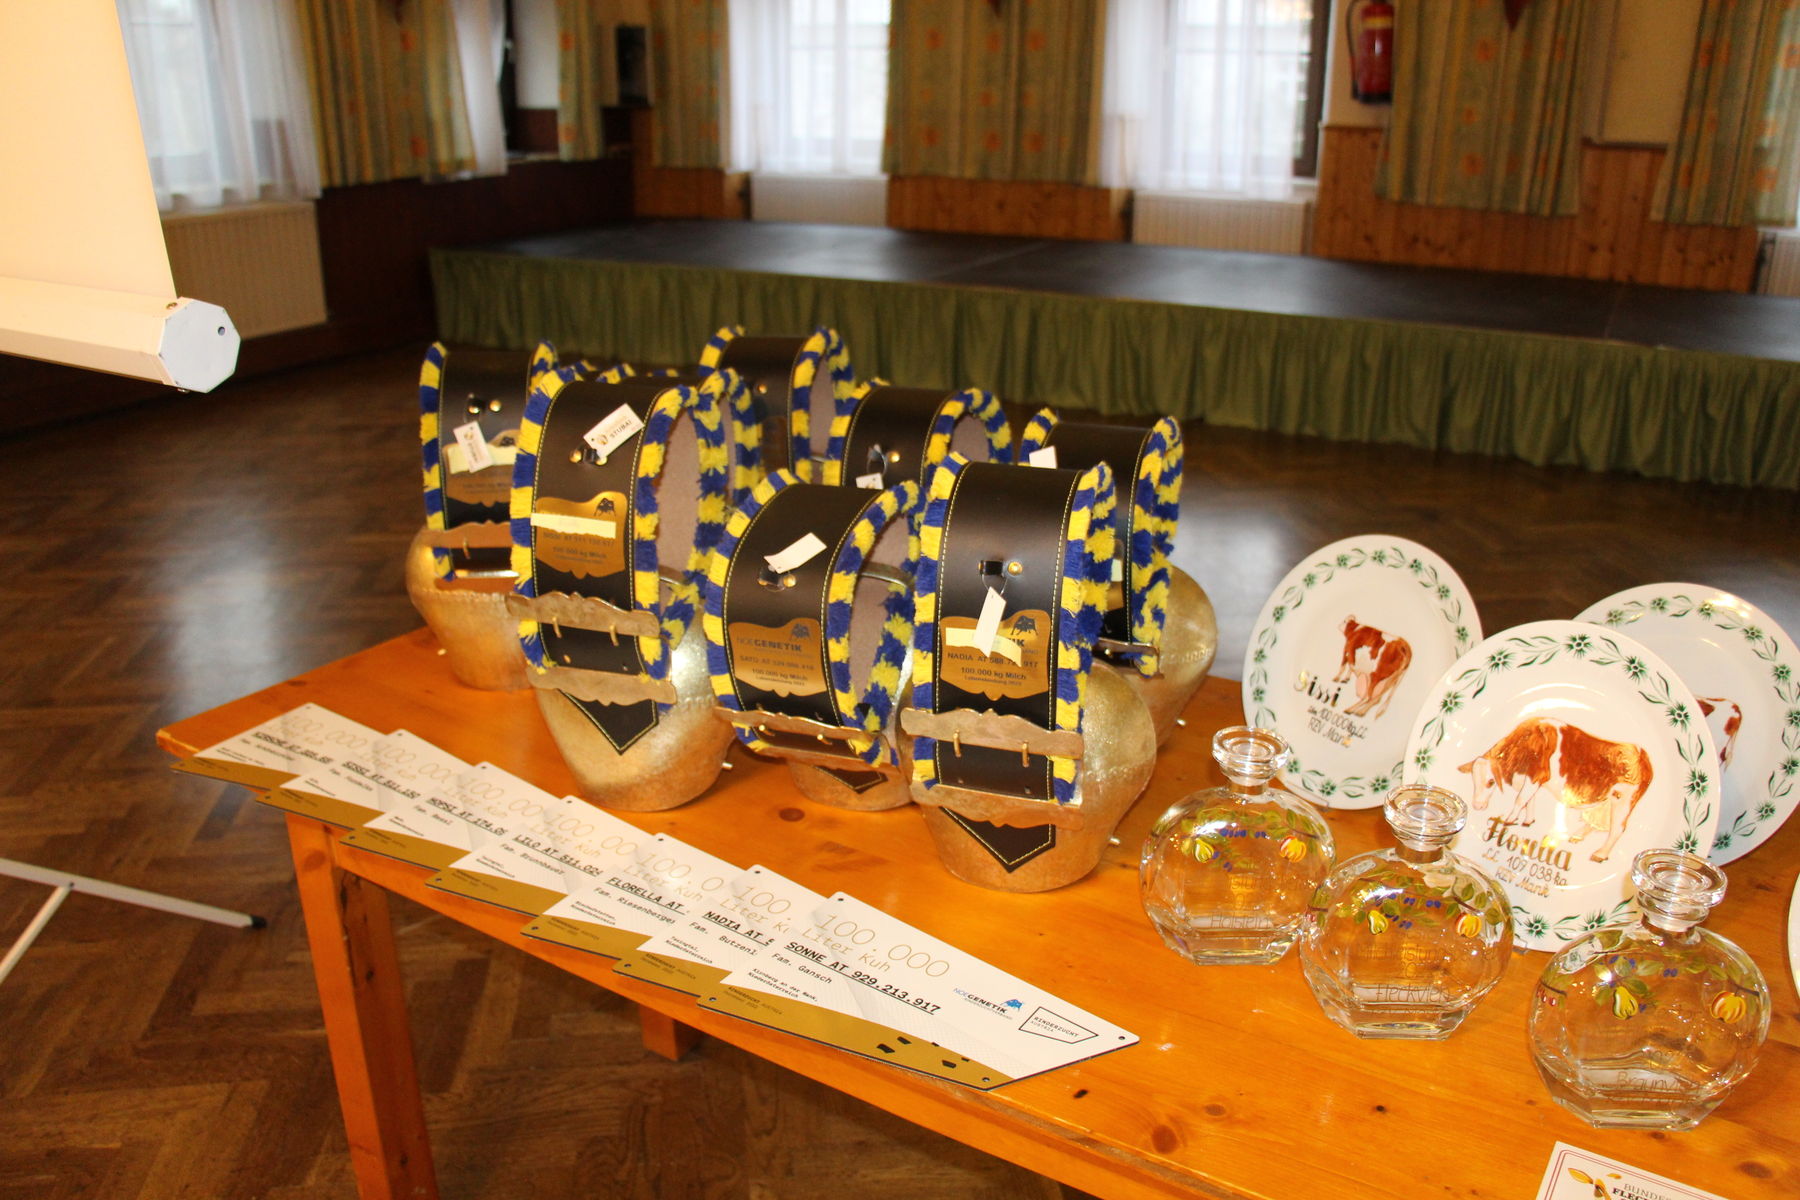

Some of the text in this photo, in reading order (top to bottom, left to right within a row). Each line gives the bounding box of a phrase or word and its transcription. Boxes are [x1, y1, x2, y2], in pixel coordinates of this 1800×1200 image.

[609, 419, 632, 438] STUBAI
[946, 651, 974, 662] NADIA
[977, 655, 988, 664] AT
[789, 673, 809, 682] Milch
[961, 666, 1027, 682] 100.000 kg Milch
[1293, 669, 1341, 708] Sissi
[426, 797, 458, 814] HOPSI
[458, 810, 474, 822] AT
[513, 833, 542, 852] LILO
[541, 846, 560, 860] AT
[1506, 855, 1528, 872] 109
[1528, 862, 1553, 882] 038
[593, 887, 613, 899] Fam.
[606, 876, 685, 914] FLORELLA AT
[675, 883, 704, 902] Kuh
[720, 898, 769, 924] Liter
[689, 920, 708, 935] Fam.
[702, 910, 741, 932] NADIA
[744, 928, 764, 941] AT
[801, 927, 892, 973] Liter Kuh
[813, 913, 951, 978] 100.000
[771, 951, 833, 985] Fam. Gansch
[784, 940, 828, 964] SONNE
[830, 960, 851, 973] AT
[850, 970, 942, 1014] 929.213.917
[1029, 1019, 1055, 1033] AUSTRIA
[1033, 1015, 1080, 1038] RINDERZUCHT
[1612, 1187, 1651, 1200] FLEC
[1623, 1183, 1672, 1200] BUNDE
